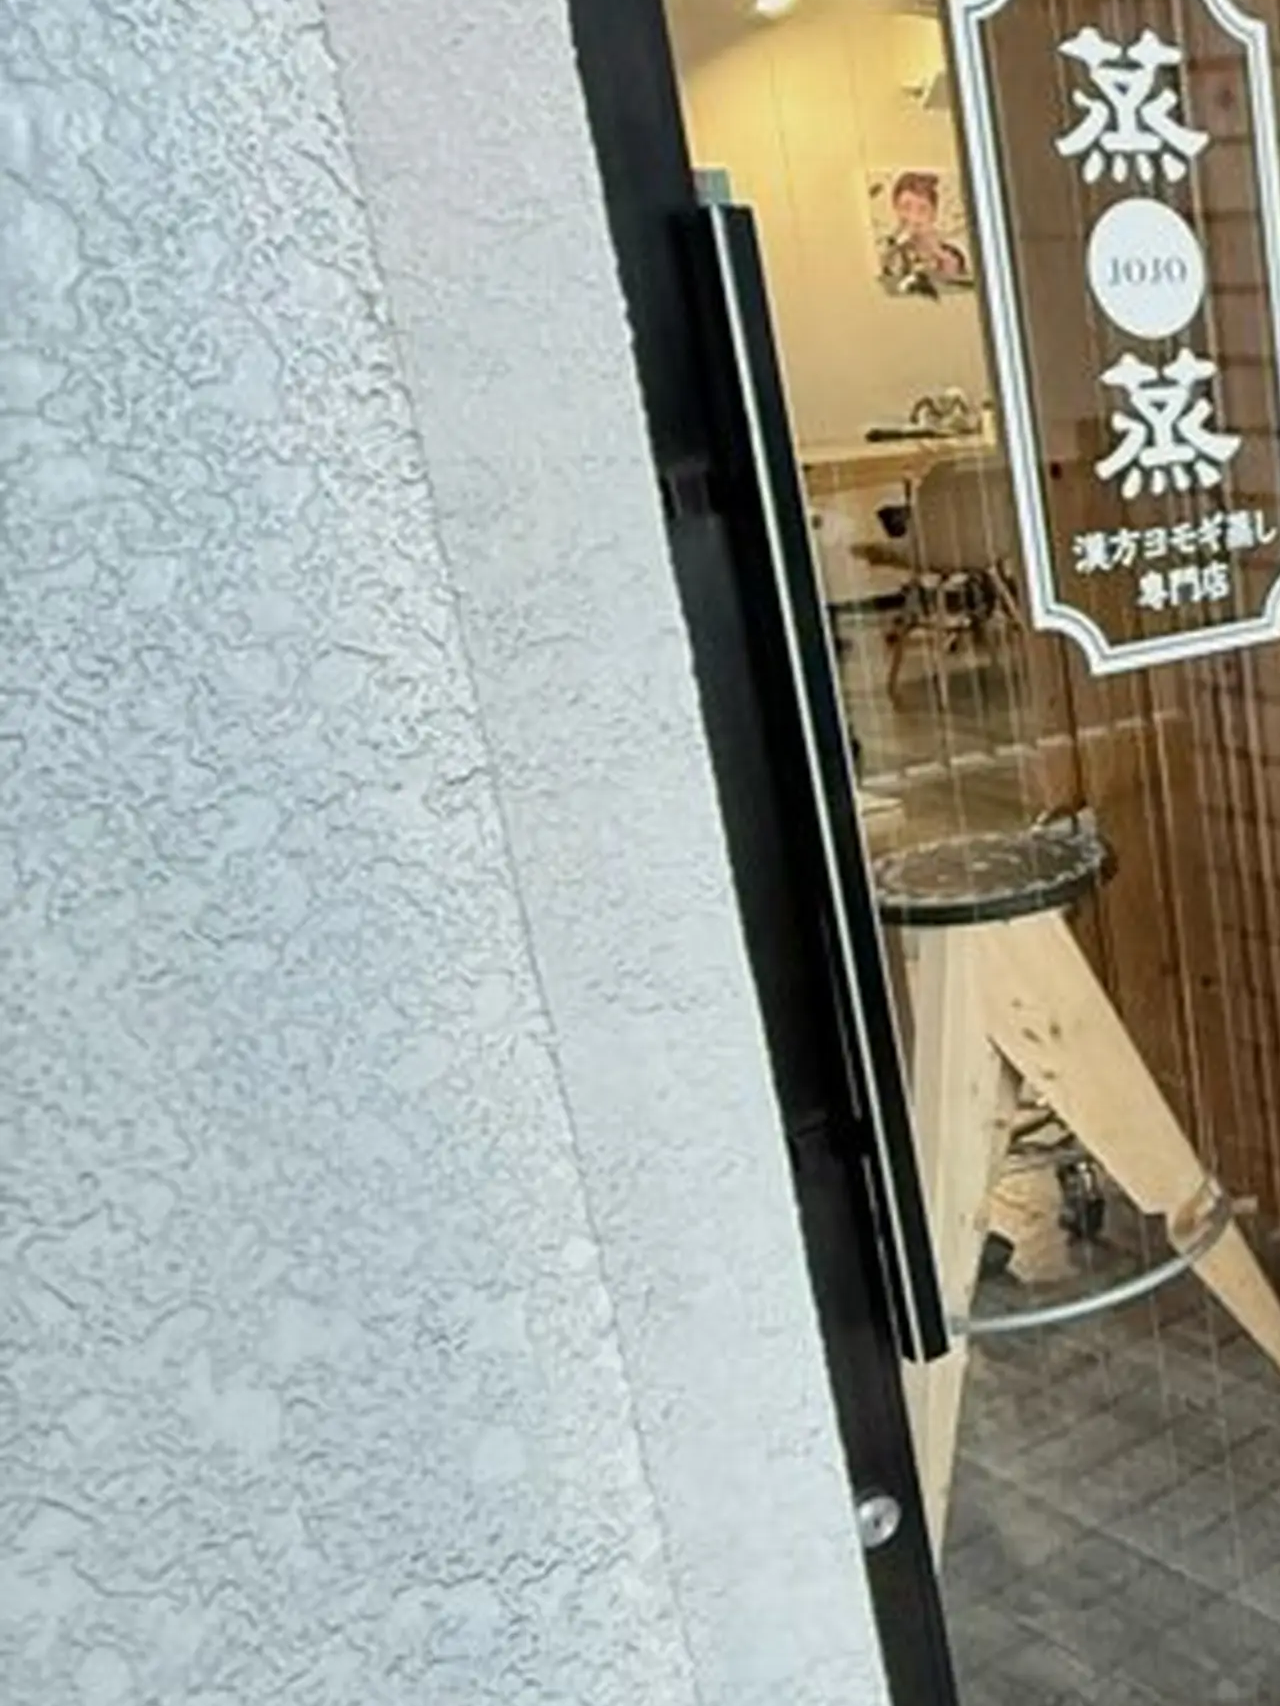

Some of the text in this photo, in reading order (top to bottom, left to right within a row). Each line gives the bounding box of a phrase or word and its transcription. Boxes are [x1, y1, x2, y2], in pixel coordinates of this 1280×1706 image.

[1055, 25, 1209, 185] 蒸
[1107, 256, 1188, 287] JOJO
[1095, 347, 1241, 499] 蒸
